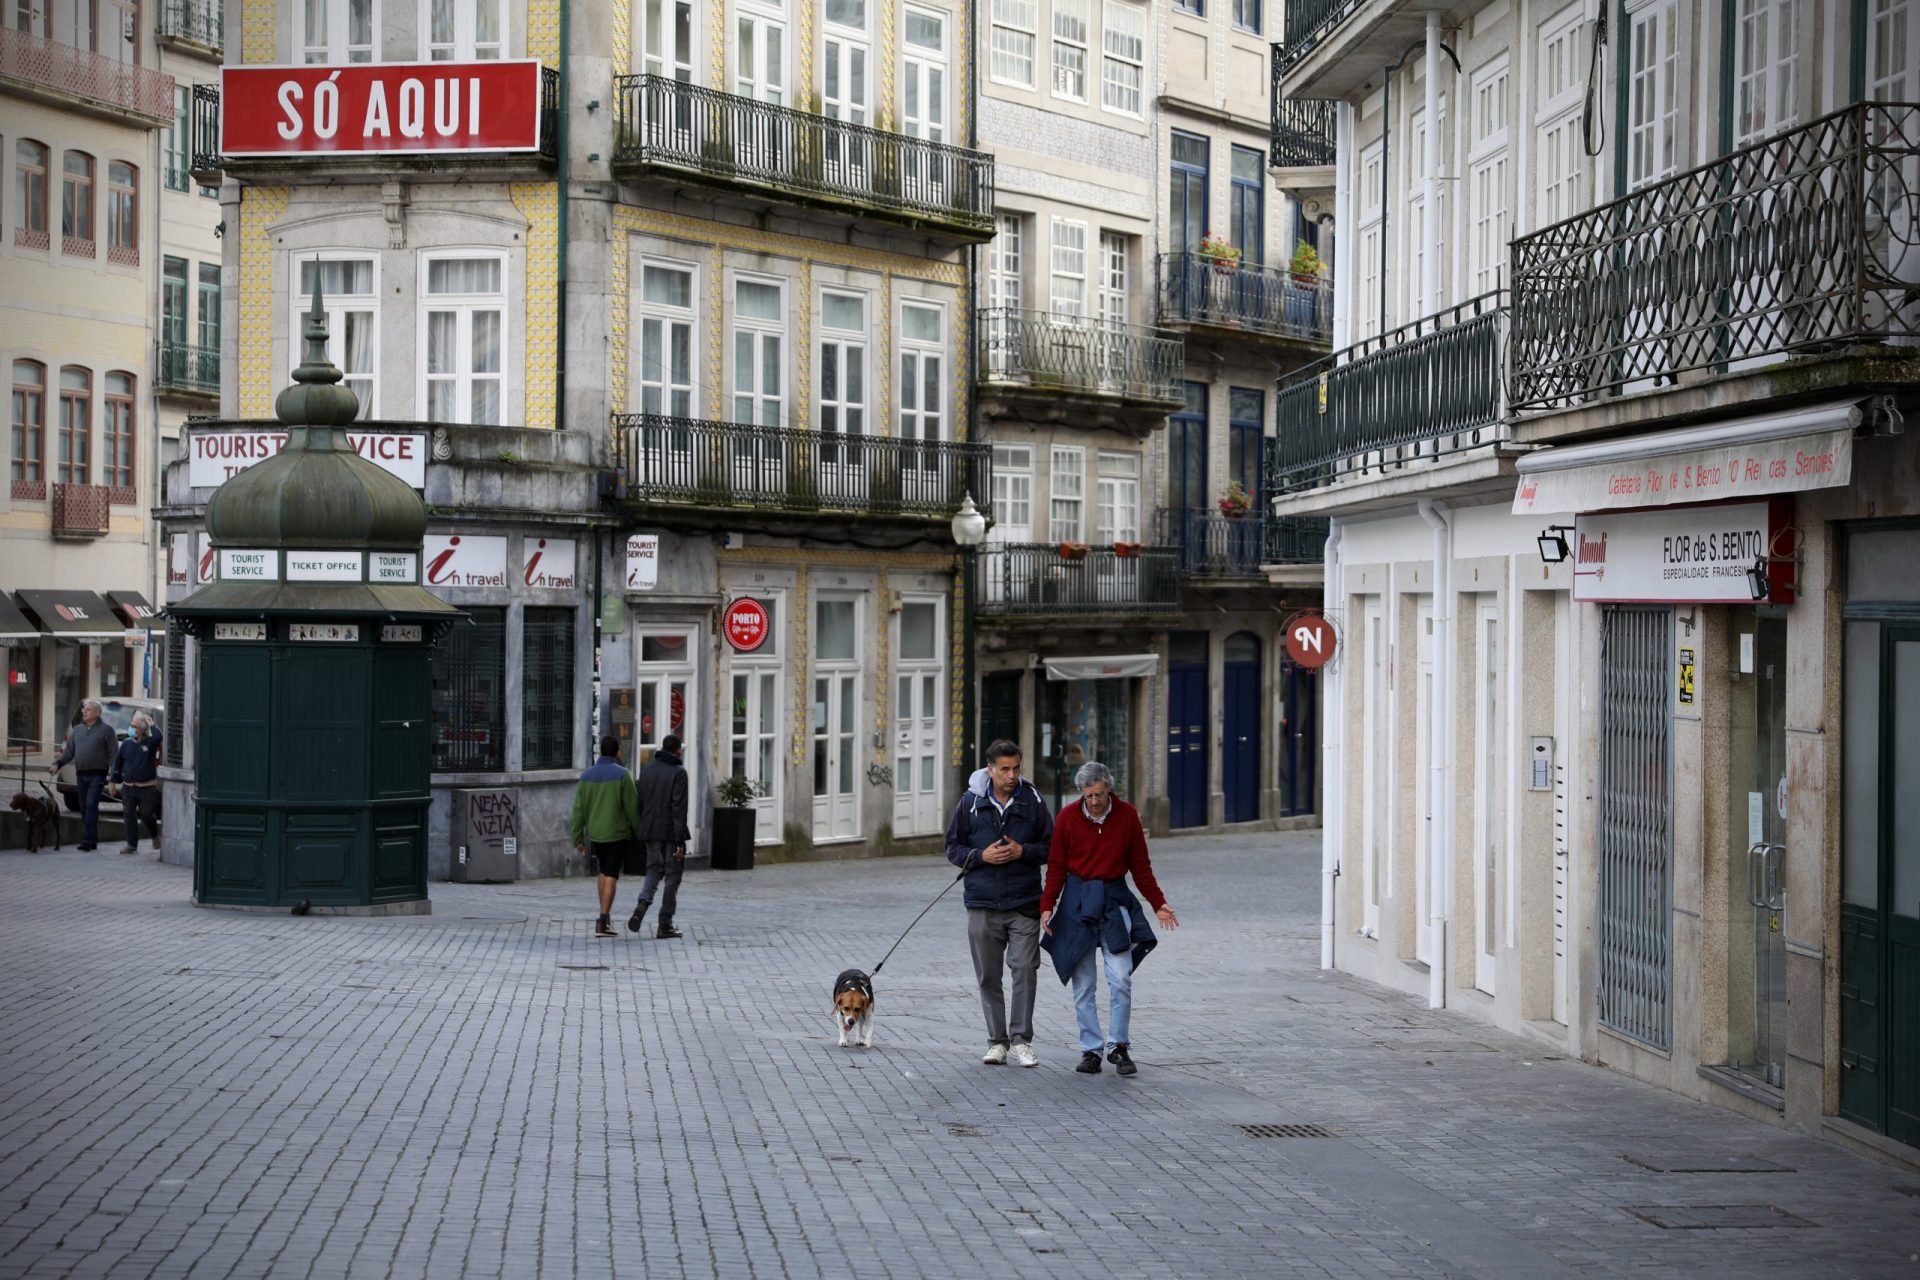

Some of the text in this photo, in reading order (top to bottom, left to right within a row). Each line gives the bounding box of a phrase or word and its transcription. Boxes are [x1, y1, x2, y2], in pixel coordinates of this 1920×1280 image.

[277, 70, 480, 140] SÓ AQUI
[195, 435, 413, 460] TOURIST VICE
[1697, 464, 1721, 488] Bento
[1745, 457, 1763, 481] Rei
[628, 541, 657, 549] TOURIST
[1663, 530, 1762, 563] FLOR de S. BENTO
[231, 554, 265, 564] TOURIST
[379, 556, 407, 565] TOURIST
[231, 566, 264, 575] SERVICE
[291, 562, 358, 571] TICKET OFFICE
[379, 568, 406, 578] SERVICE
[466, 572, 504, 586] travel
[1663, 566, 1709, 580] ESPECIALIDADE
[548, 574, 573, 588] travel
[732, 613, 760, 624] PORTO
